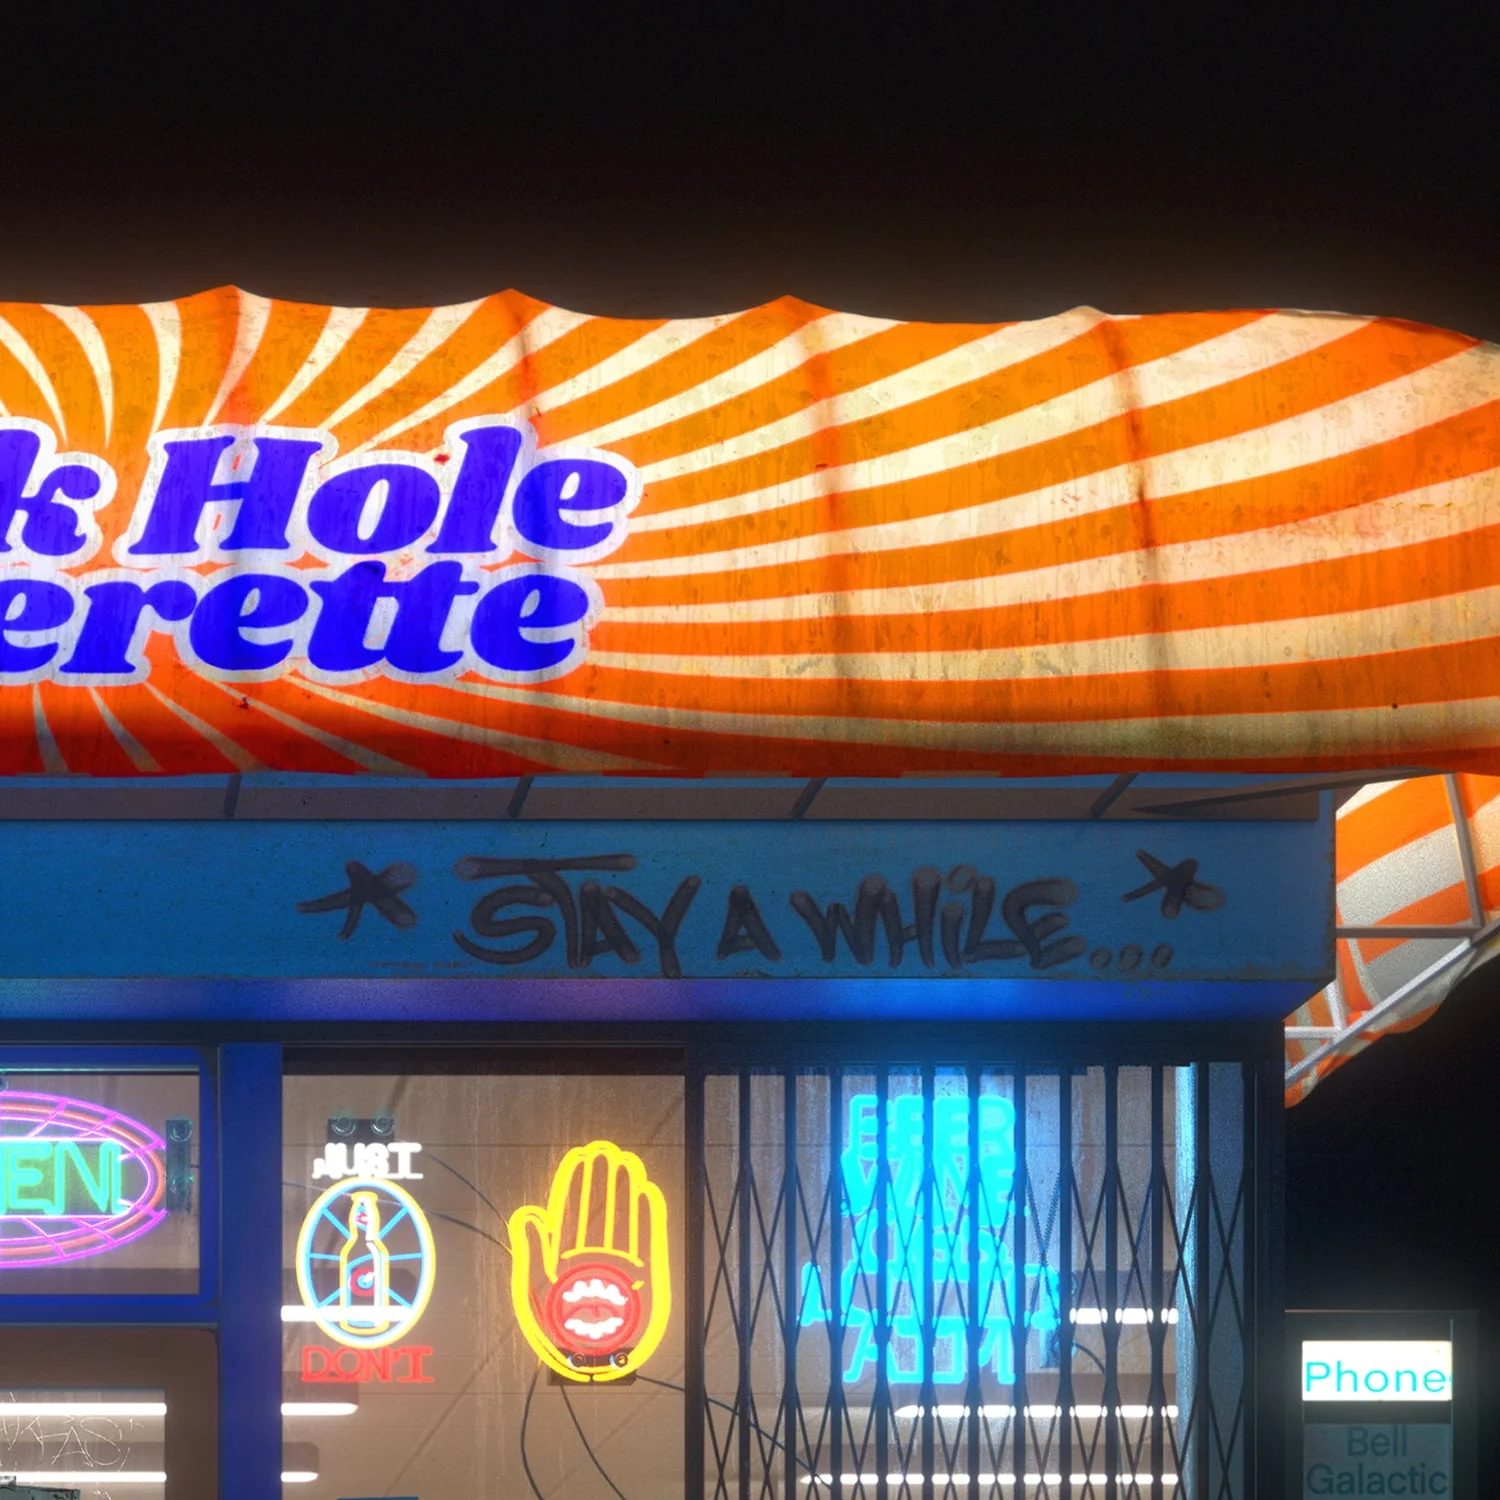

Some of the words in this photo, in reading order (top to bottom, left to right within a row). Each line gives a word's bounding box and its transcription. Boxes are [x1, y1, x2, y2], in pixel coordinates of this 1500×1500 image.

[129, 424, 628, 556] Hole
[452, 853, 700, 977] STAY
[716, 884, 780, 962] A
[312, 1142, 423, 1179] JUST
[301, 1346, 435, 1383] DON'T
[1305, 1360, 1447, 1393] Phone
[1346, 1425, 1409, 1458] Bell
[1306, 1462, 1448, 1496] Galactic
